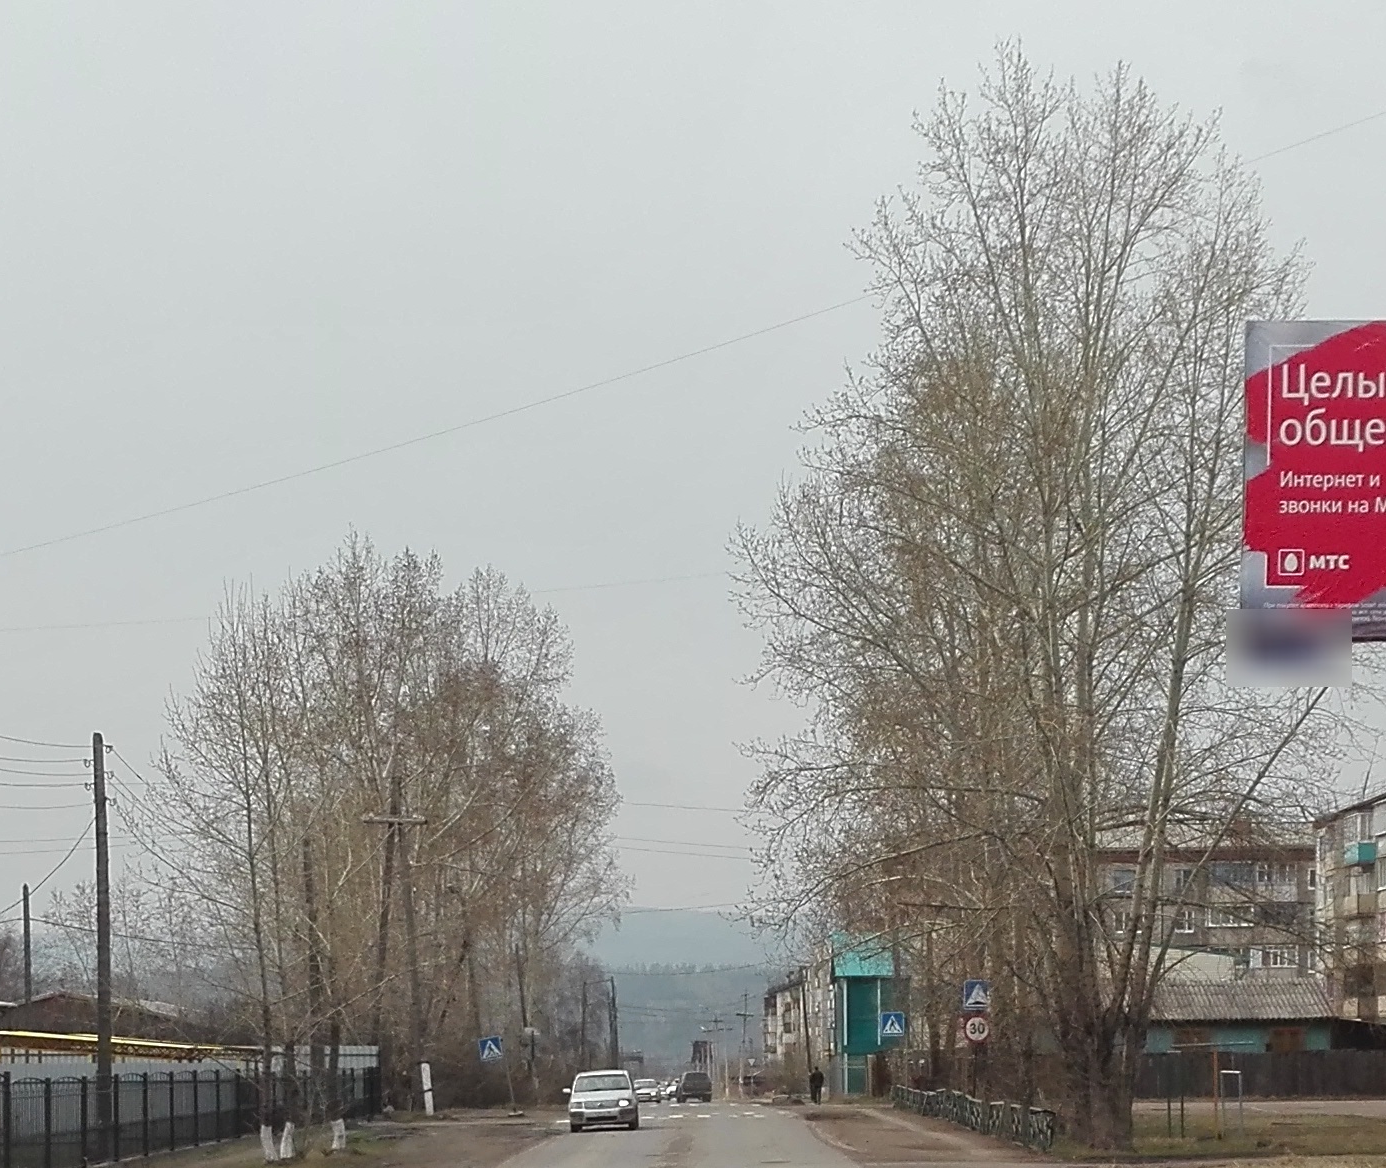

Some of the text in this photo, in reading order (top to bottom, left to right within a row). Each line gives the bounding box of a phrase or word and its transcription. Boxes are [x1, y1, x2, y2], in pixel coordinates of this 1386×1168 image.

[1279, 470, 1381, 492] Интернет и
[1279, 499, 1342, 514] звонки
[1348, 499, 1369, 514] на
[1309, 554, 1350, 570] МТС
[969, 1022, 986, 1035] 30
